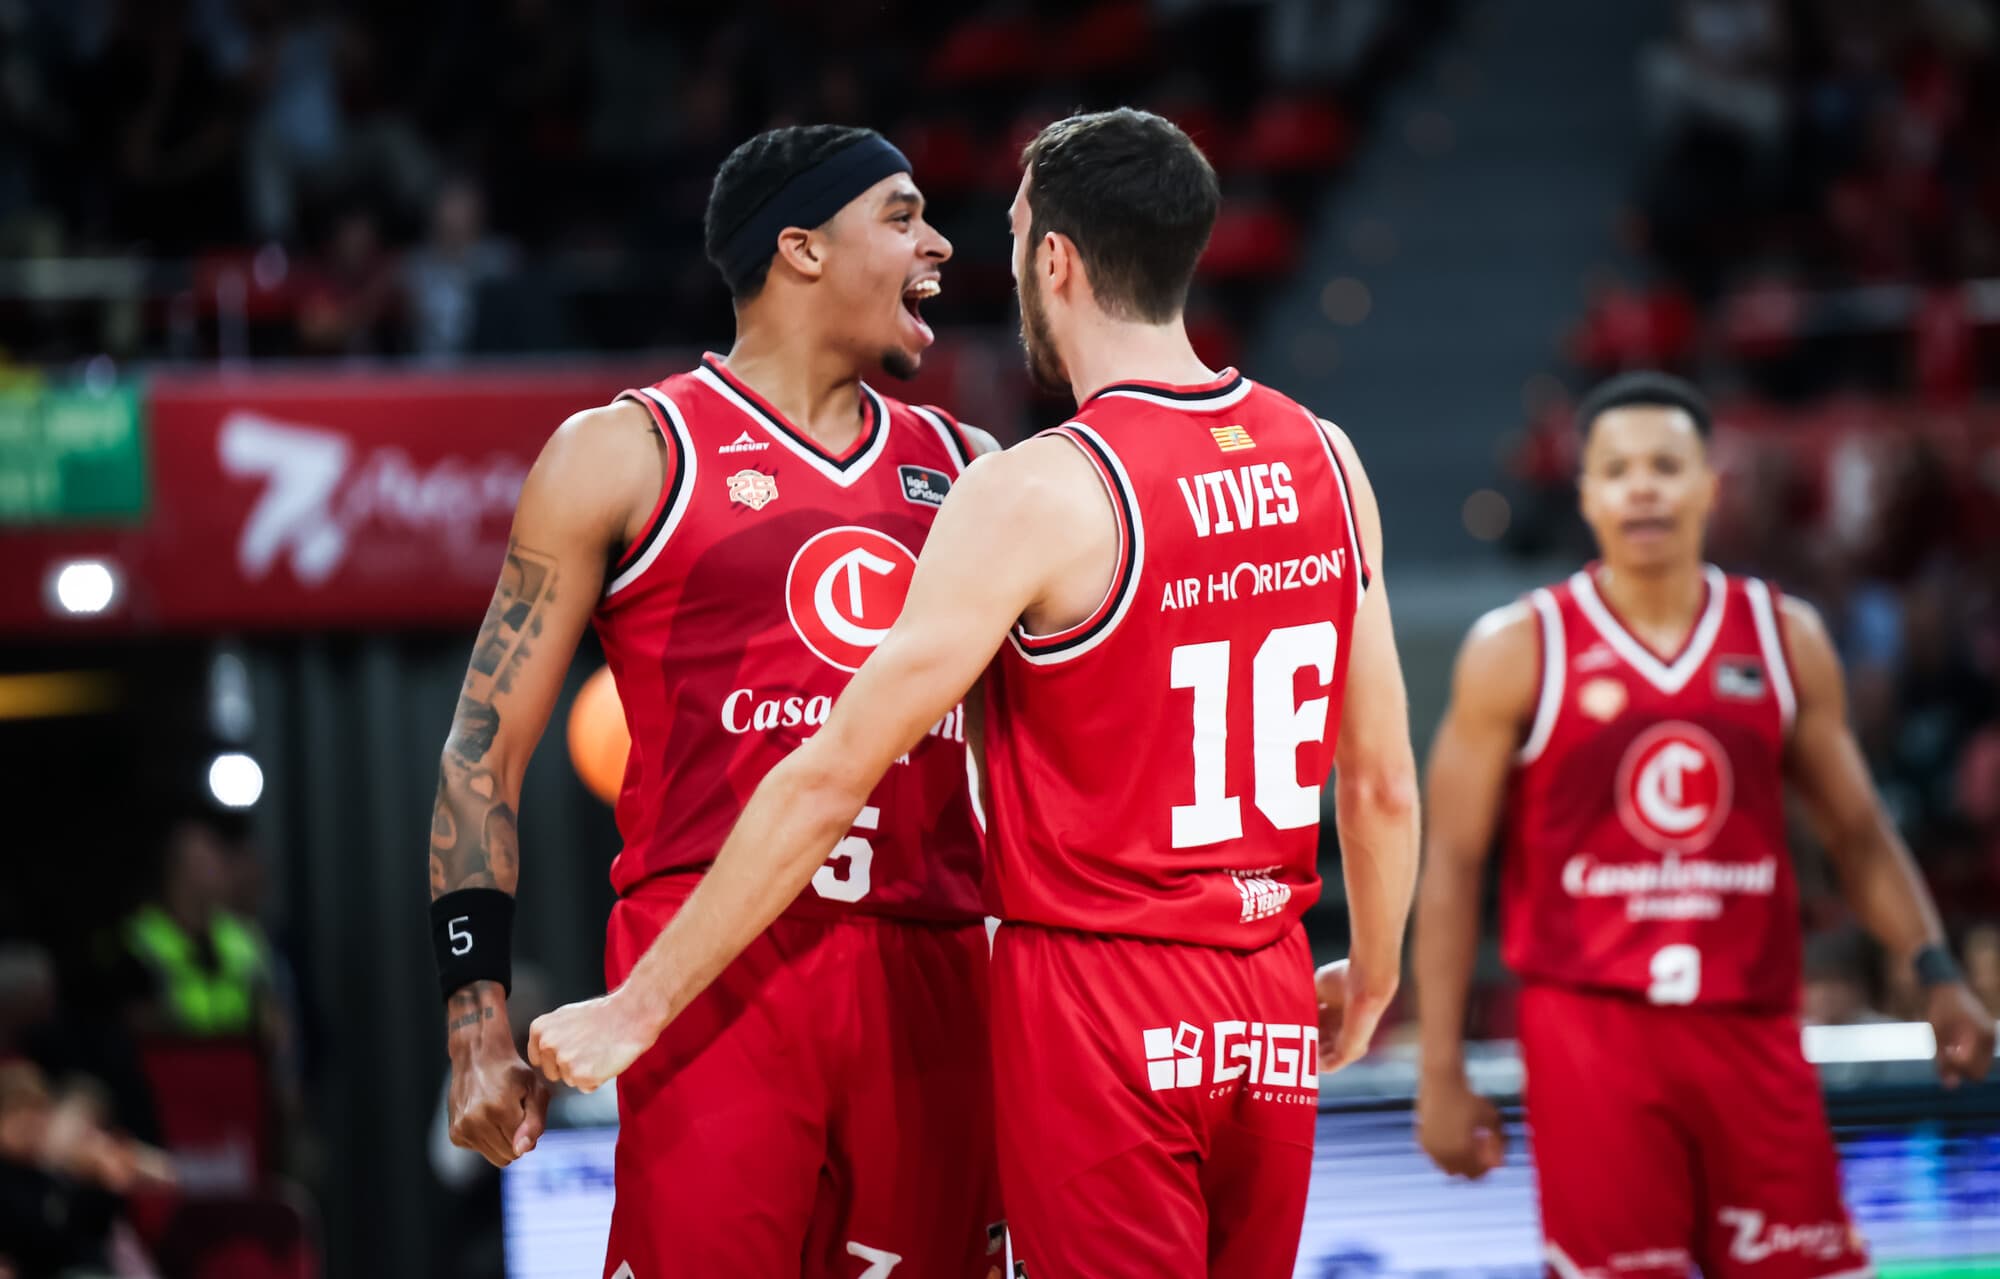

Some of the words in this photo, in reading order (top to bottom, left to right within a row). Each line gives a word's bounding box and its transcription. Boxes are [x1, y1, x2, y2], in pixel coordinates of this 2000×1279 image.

[718, 442, 770, 455] MERCURY
[1177, 461, 1300, 538] VIVES
[1160, 578, 1202, 612] AIR
[721, 687, 965, 744] Casant
[1170, 620, 1338, 849] 16
[811, 806, 881, 904] 5
[447, 915, 474, 957] 5
